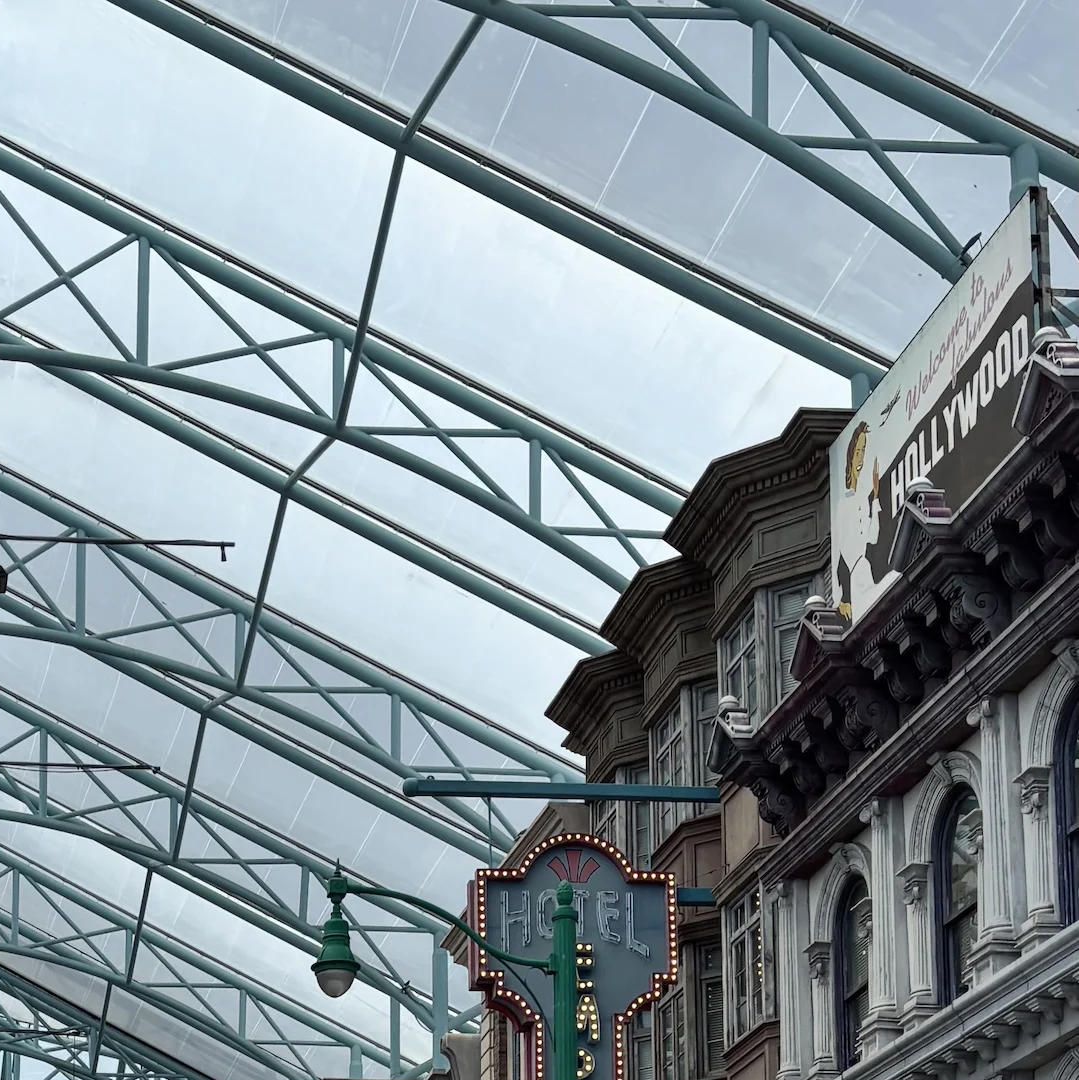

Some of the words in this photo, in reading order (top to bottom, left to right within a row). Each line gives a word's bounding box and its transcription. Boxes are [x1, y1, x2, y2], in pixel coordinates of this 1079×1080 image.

[906, 306, 967, 421] Welcome
[971, 272, 984, 307] to
[950, 257, 1014, 389] fabulous
[891, 314, 1030, 519] HOLLYWOOD
[500, 889, 650, 959] HOTEL
